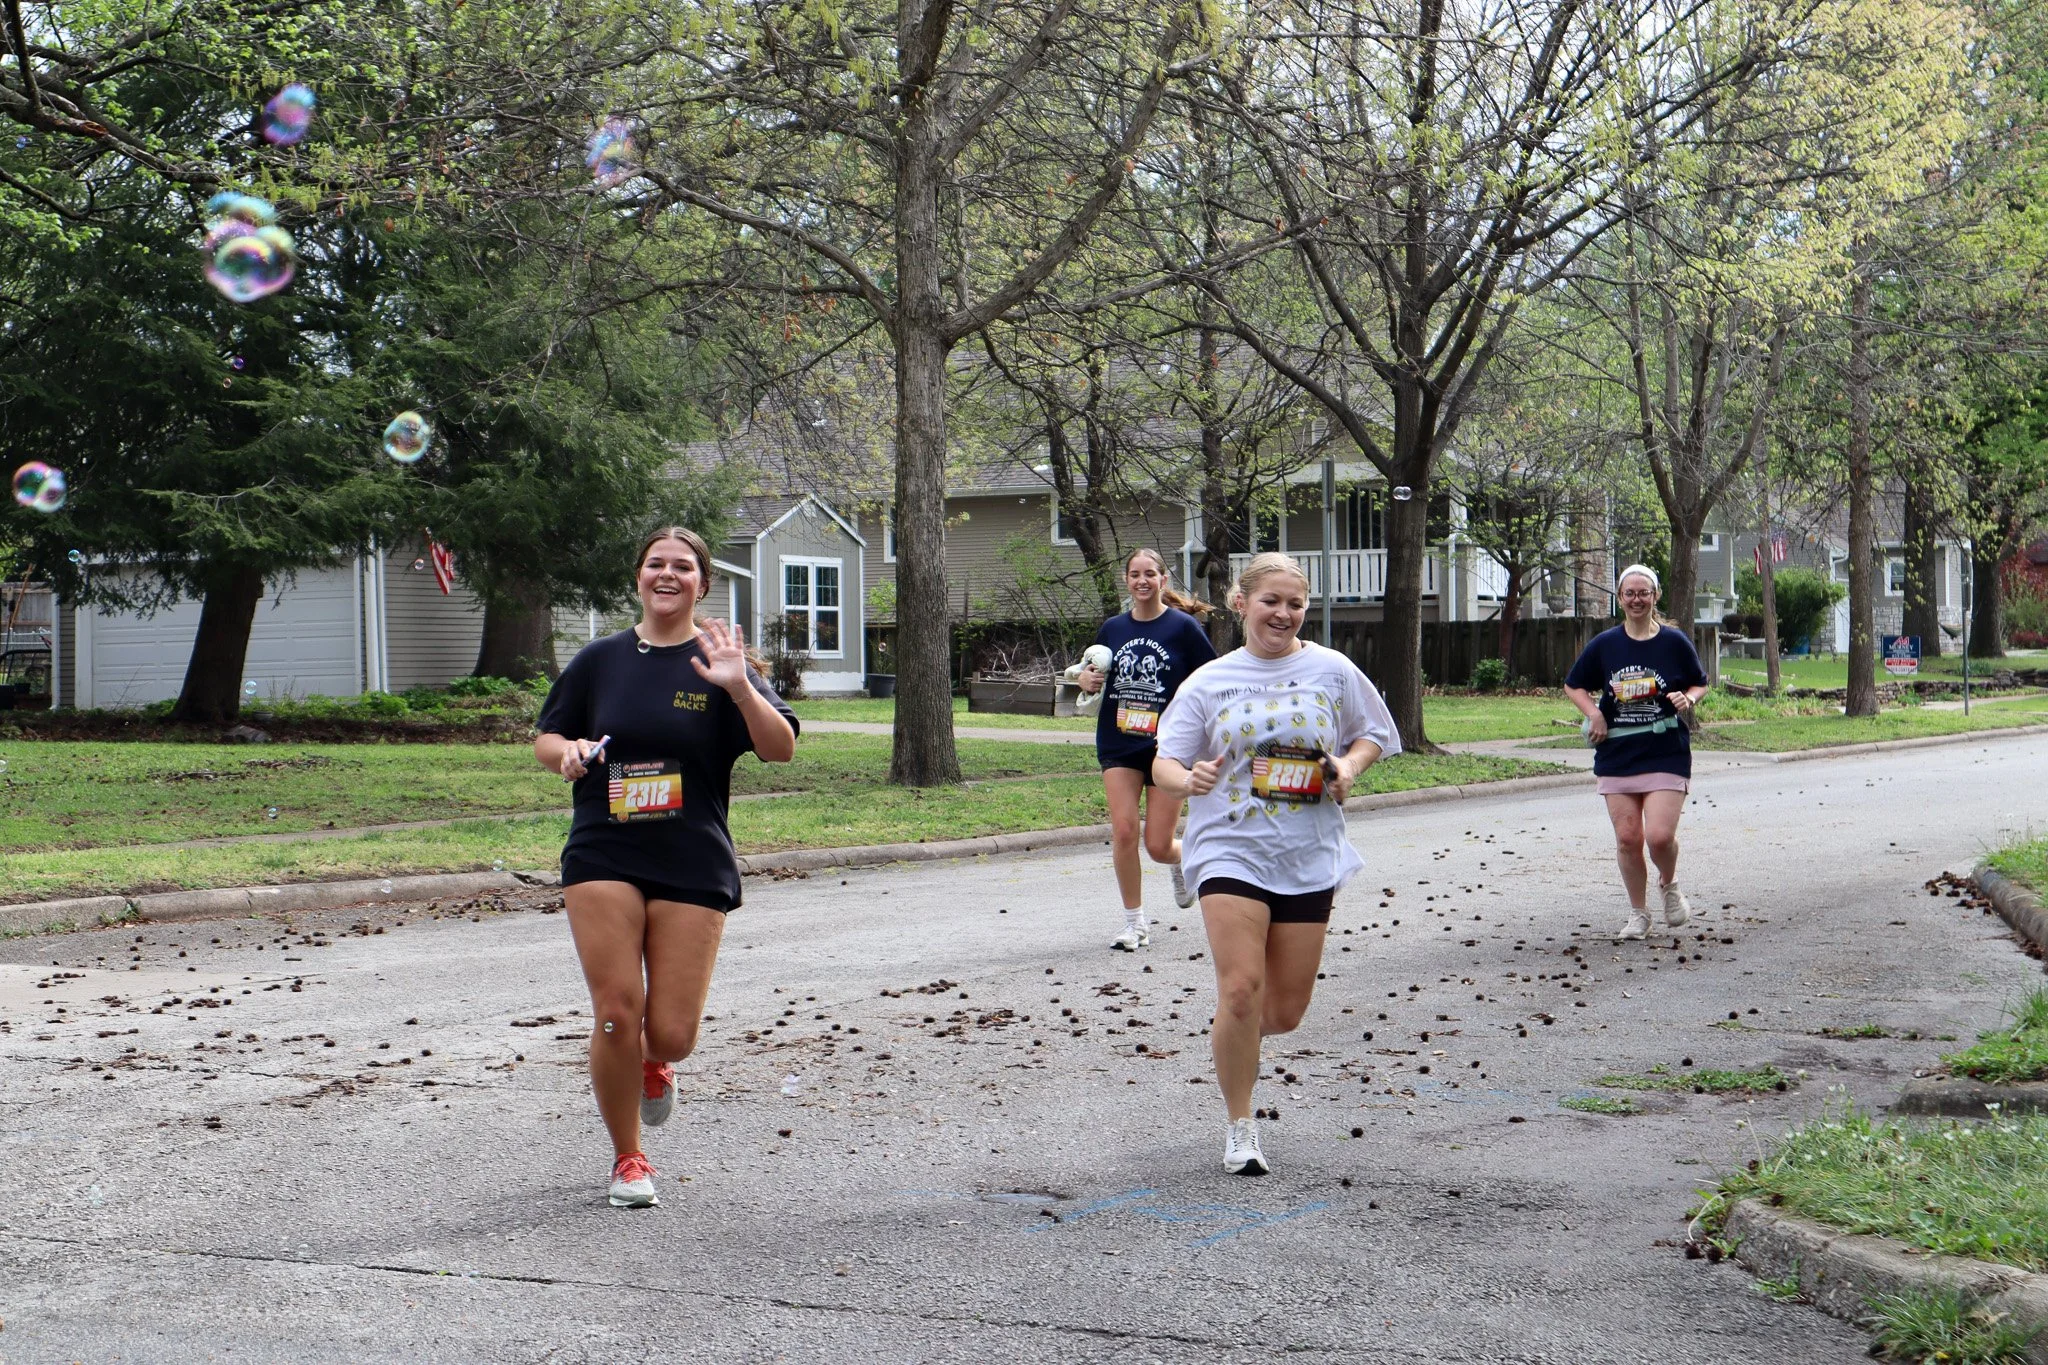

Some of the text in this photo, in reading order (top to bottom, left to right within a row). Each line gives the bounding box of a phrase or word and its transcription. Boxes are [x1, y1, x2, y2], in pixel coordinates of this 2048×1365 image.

[1145, 638, 1170, 661] HOUSE
[673, 698, 706, 712] BACKS
[1268, 762, 1314, 789] 2261
[624, 780, 670, 808] 2312
